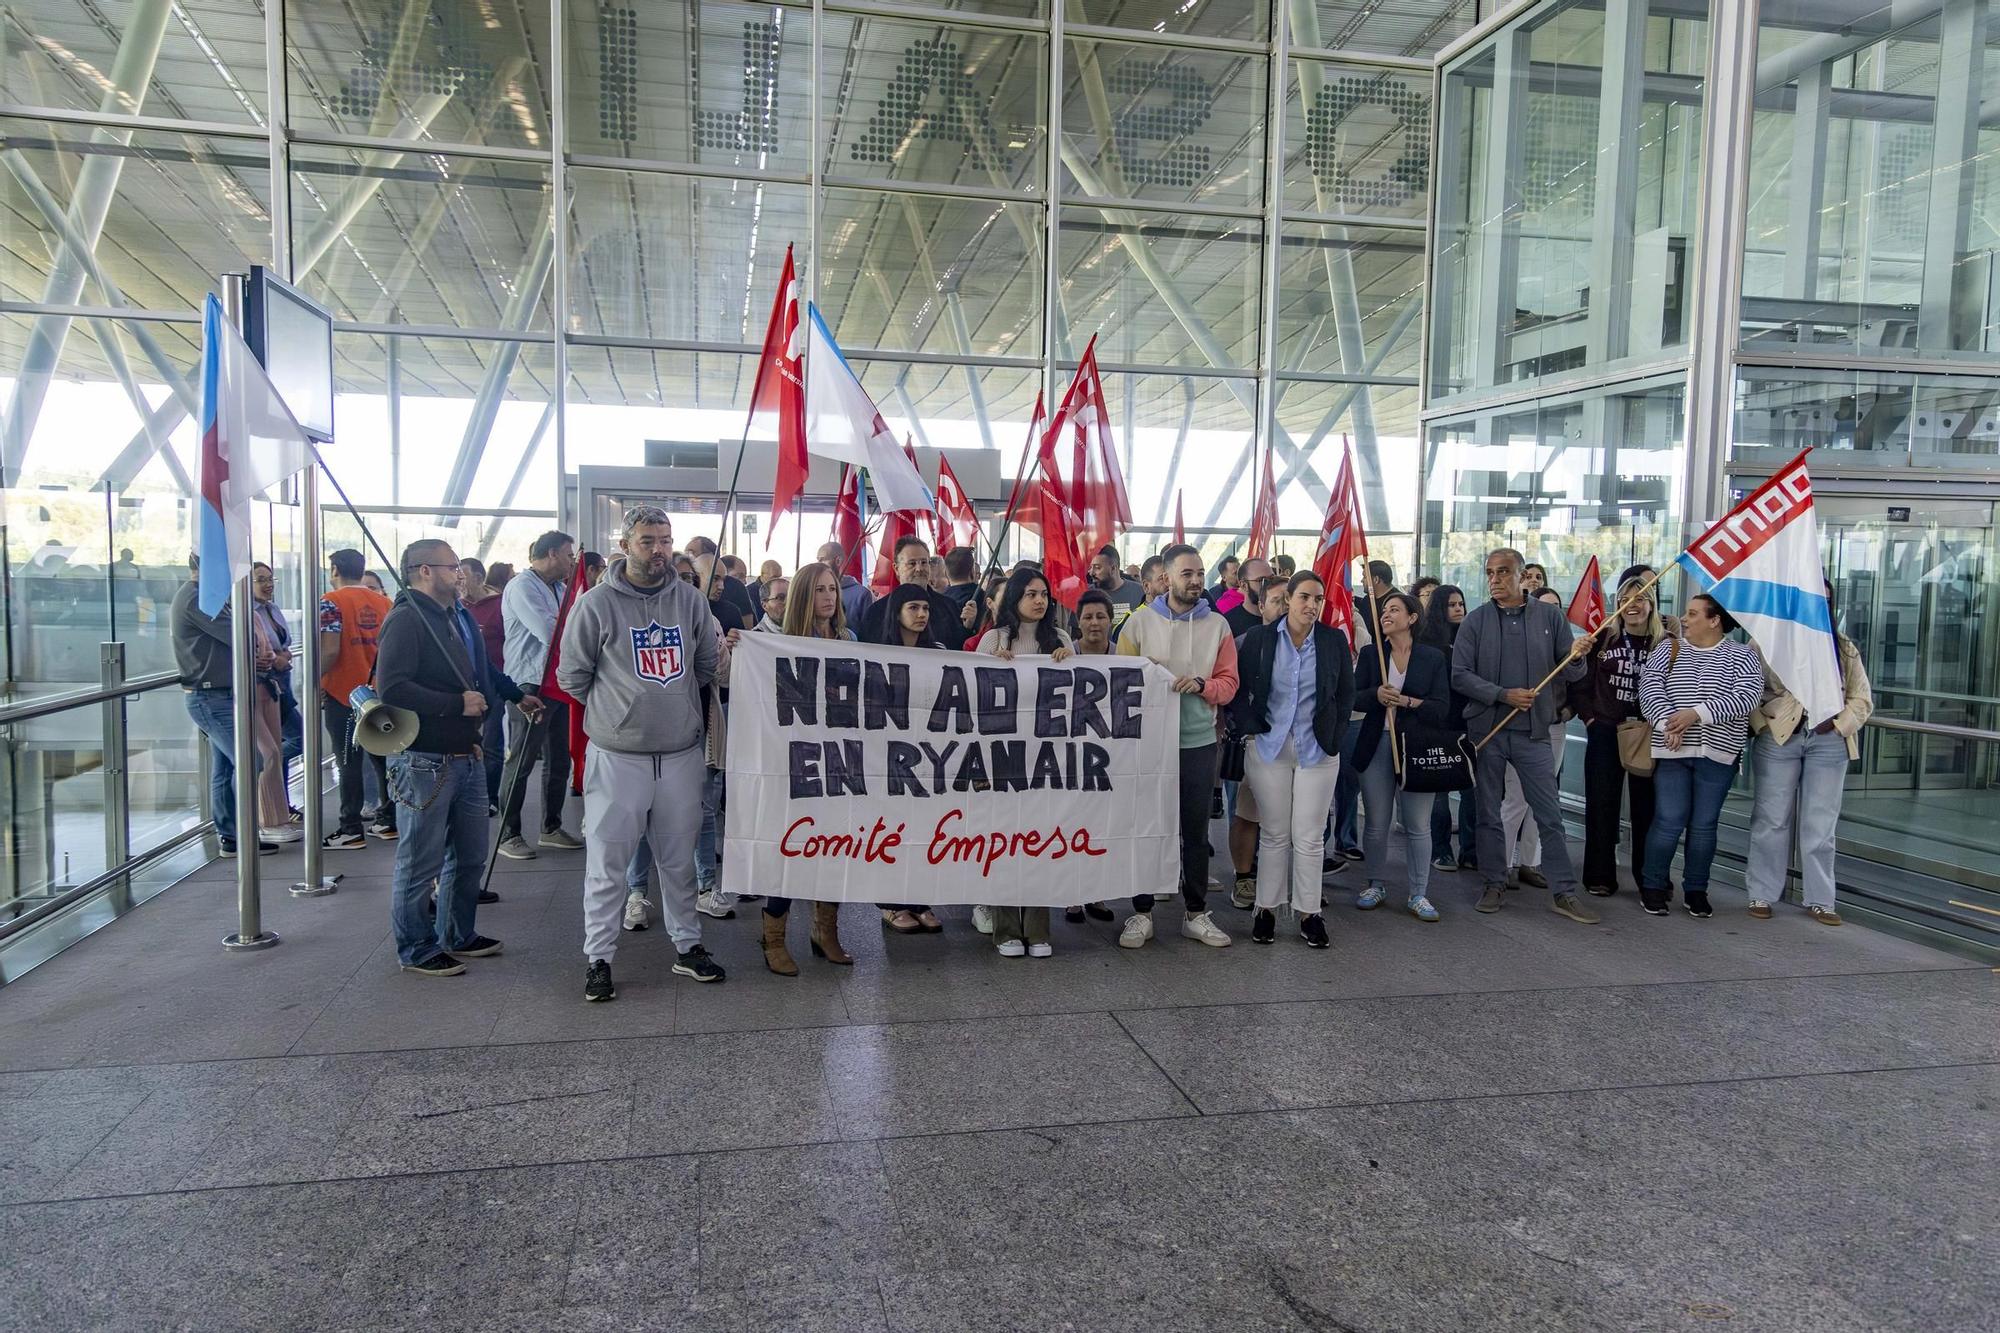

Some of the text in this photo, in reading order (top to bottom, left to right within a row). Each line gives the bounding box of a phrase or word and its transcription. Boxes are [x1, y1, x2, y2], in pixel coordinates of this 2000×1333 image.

[640, 649, 680, 677] NFL
[775, 656, 911, 731] NON
[1033, 666, 1145, 740] ERE
[788, 738, 1113, 800] EN RYANAIR
[1412, 755, 1462, 765] TOTE BAG
[1426, 747, 1445, 756] THE
[780, 808, 1107, 878] Comité Empresa
